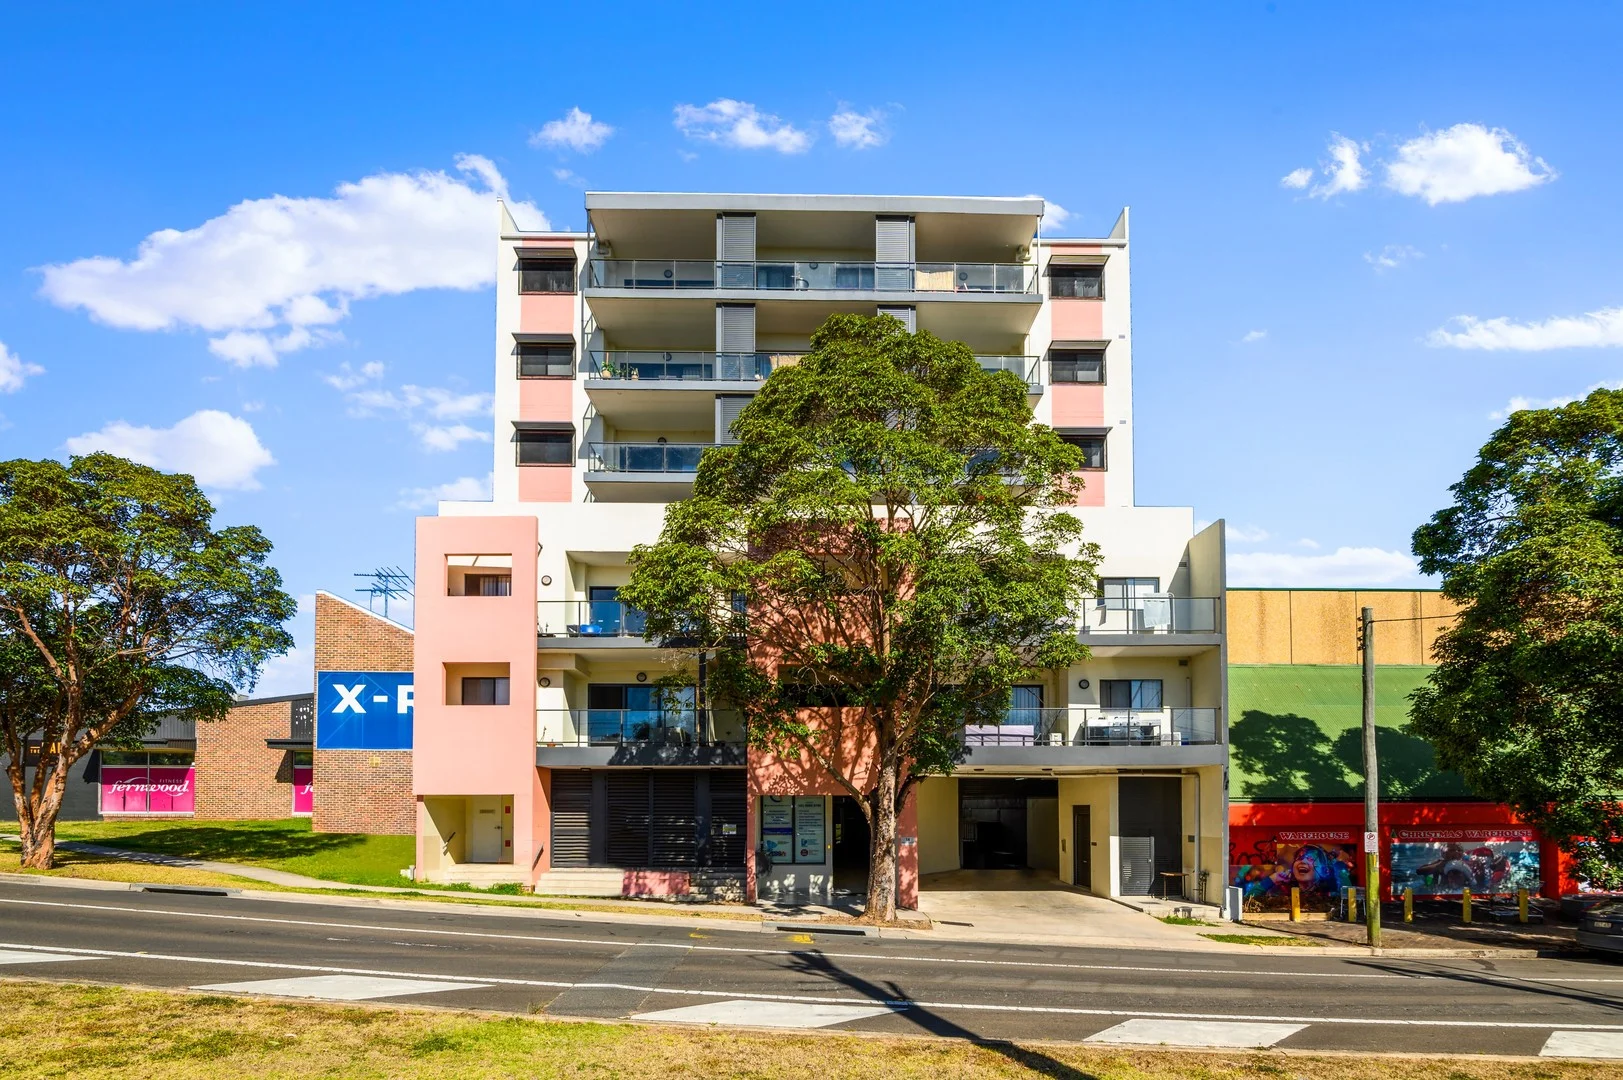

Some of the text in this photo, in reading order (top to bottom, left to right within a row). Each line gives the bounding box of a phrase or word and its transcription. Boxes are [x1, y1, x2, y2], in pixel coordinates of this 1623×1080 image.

[108, 780, 189, 794] fernwood
[1279, 831, 1350, 840] WAREHOUSE
[1399, 829, 1532, 838] CHRISTMAS WAREHOUSE
